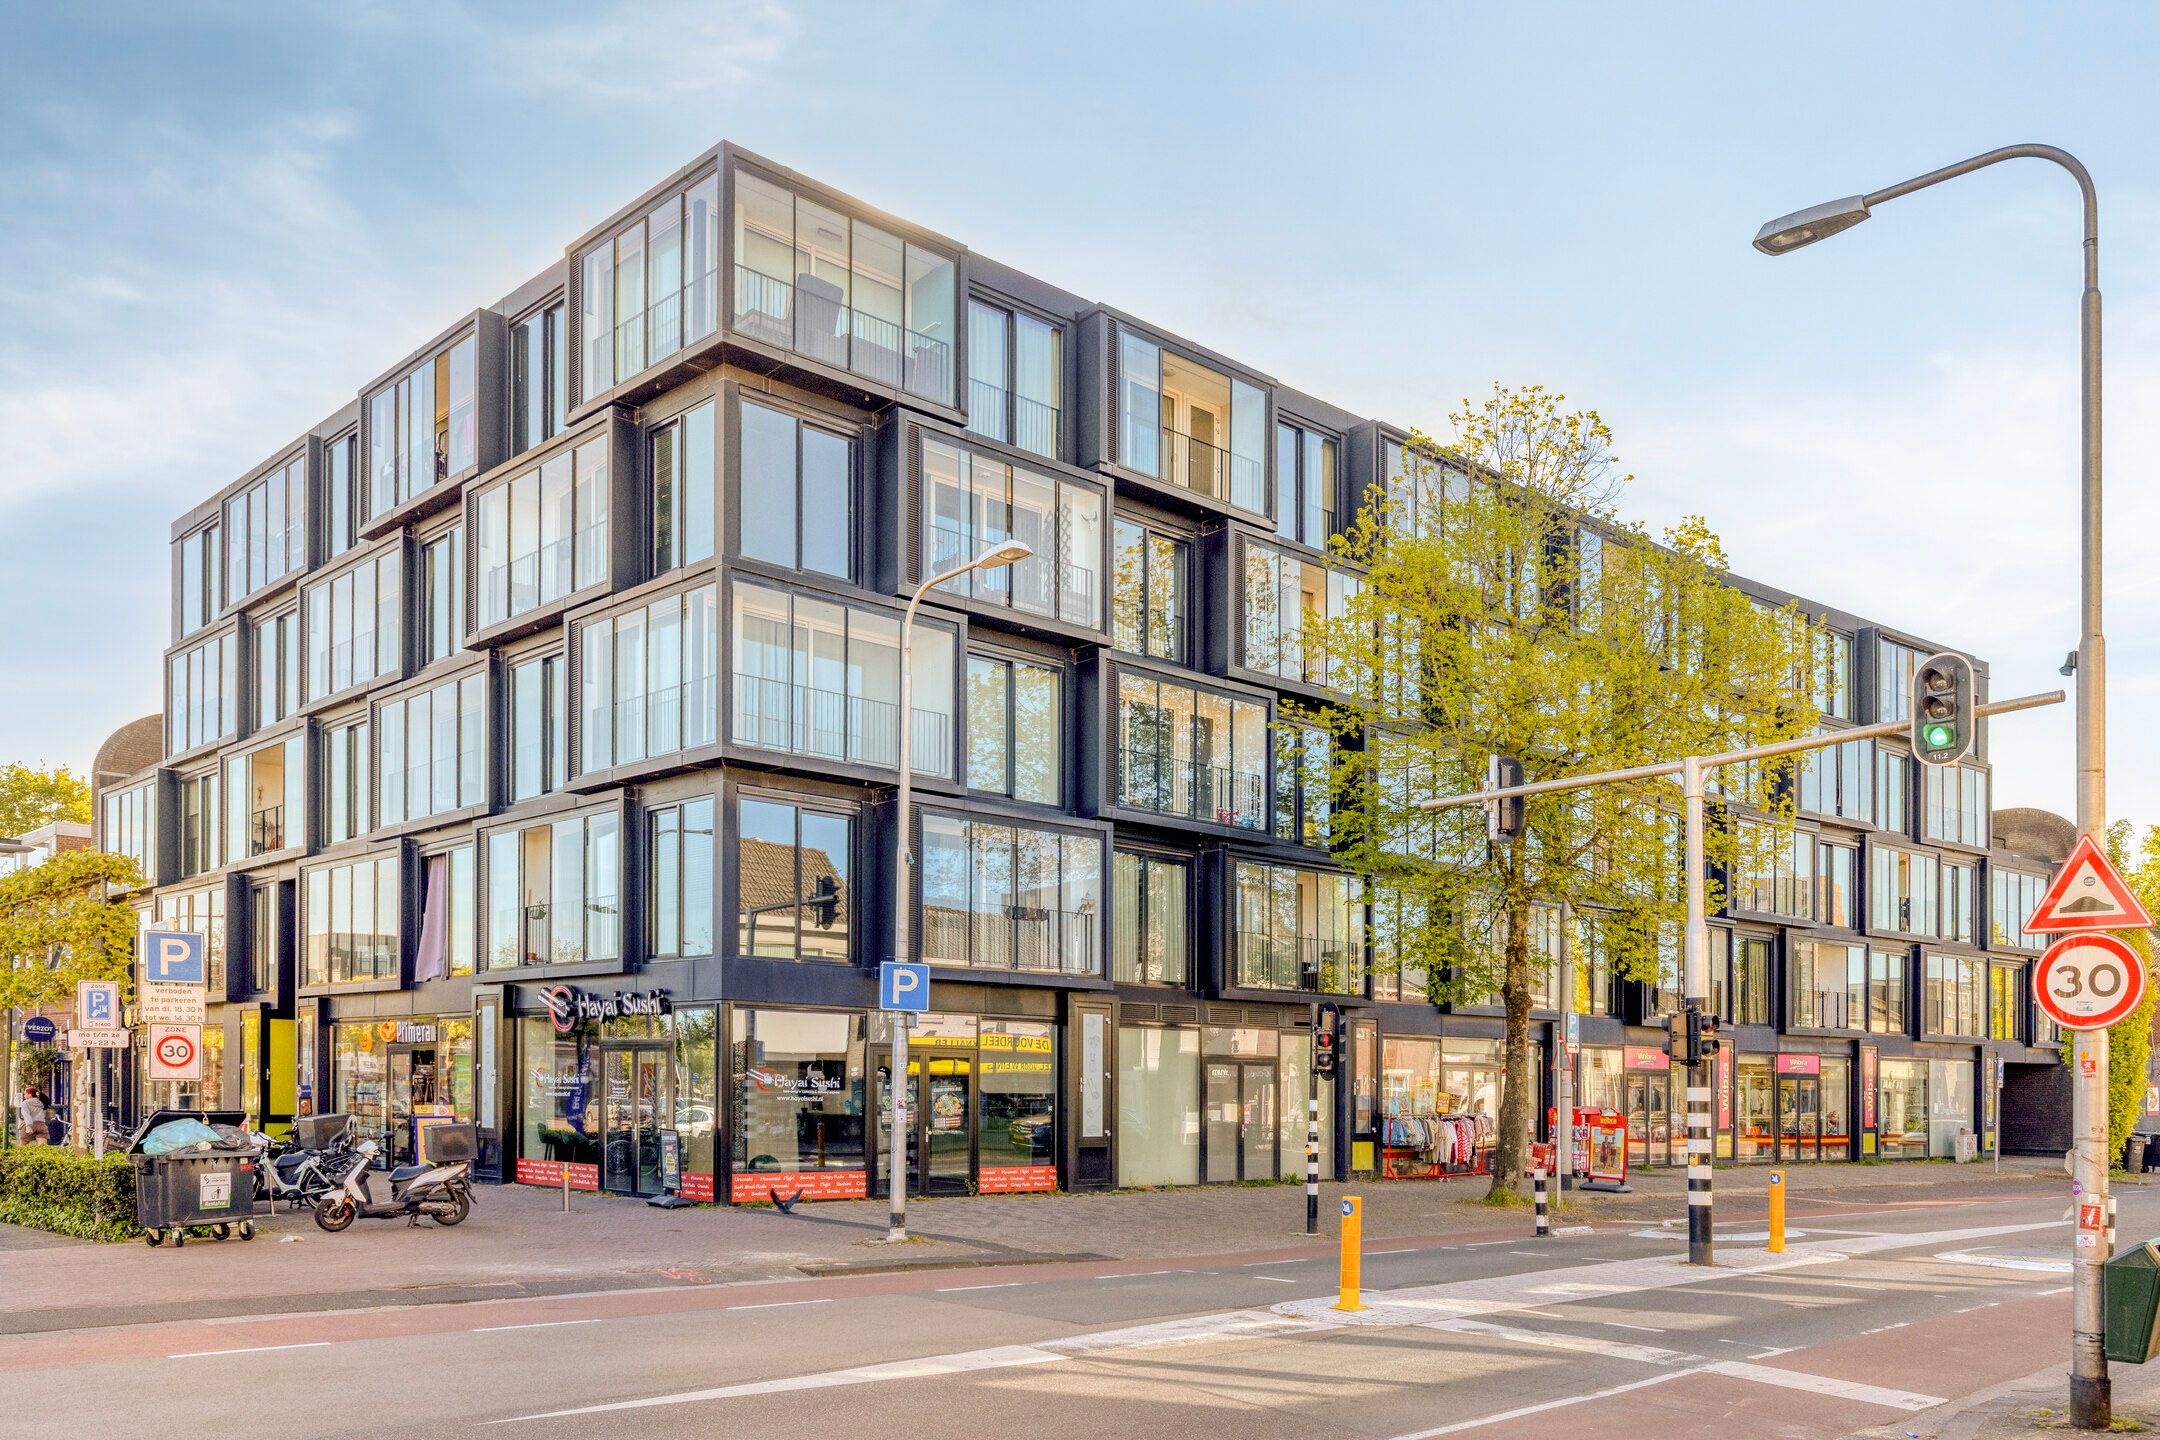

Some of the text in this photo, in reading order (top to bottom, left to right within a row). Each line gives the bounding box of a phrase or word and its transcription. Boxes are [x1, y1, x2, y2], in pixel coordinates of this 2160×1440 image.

[1933, 752, 1949, 760] 11.2
[159, 937, 191, 977] P
[892, 968, 919, 1005] P
[2053, 963, 2121, 999] 30
[92, 992, 105, 1008] P
[161, 997, 197, 1005] parkeren
[577, 989, 664, 1022] Hayai Sushi
[396, 1021, 432, 1042] Primera
[163, 1045, 188, 1058] 30
[774, 1075, 840, 1090] Hayai Sushi
